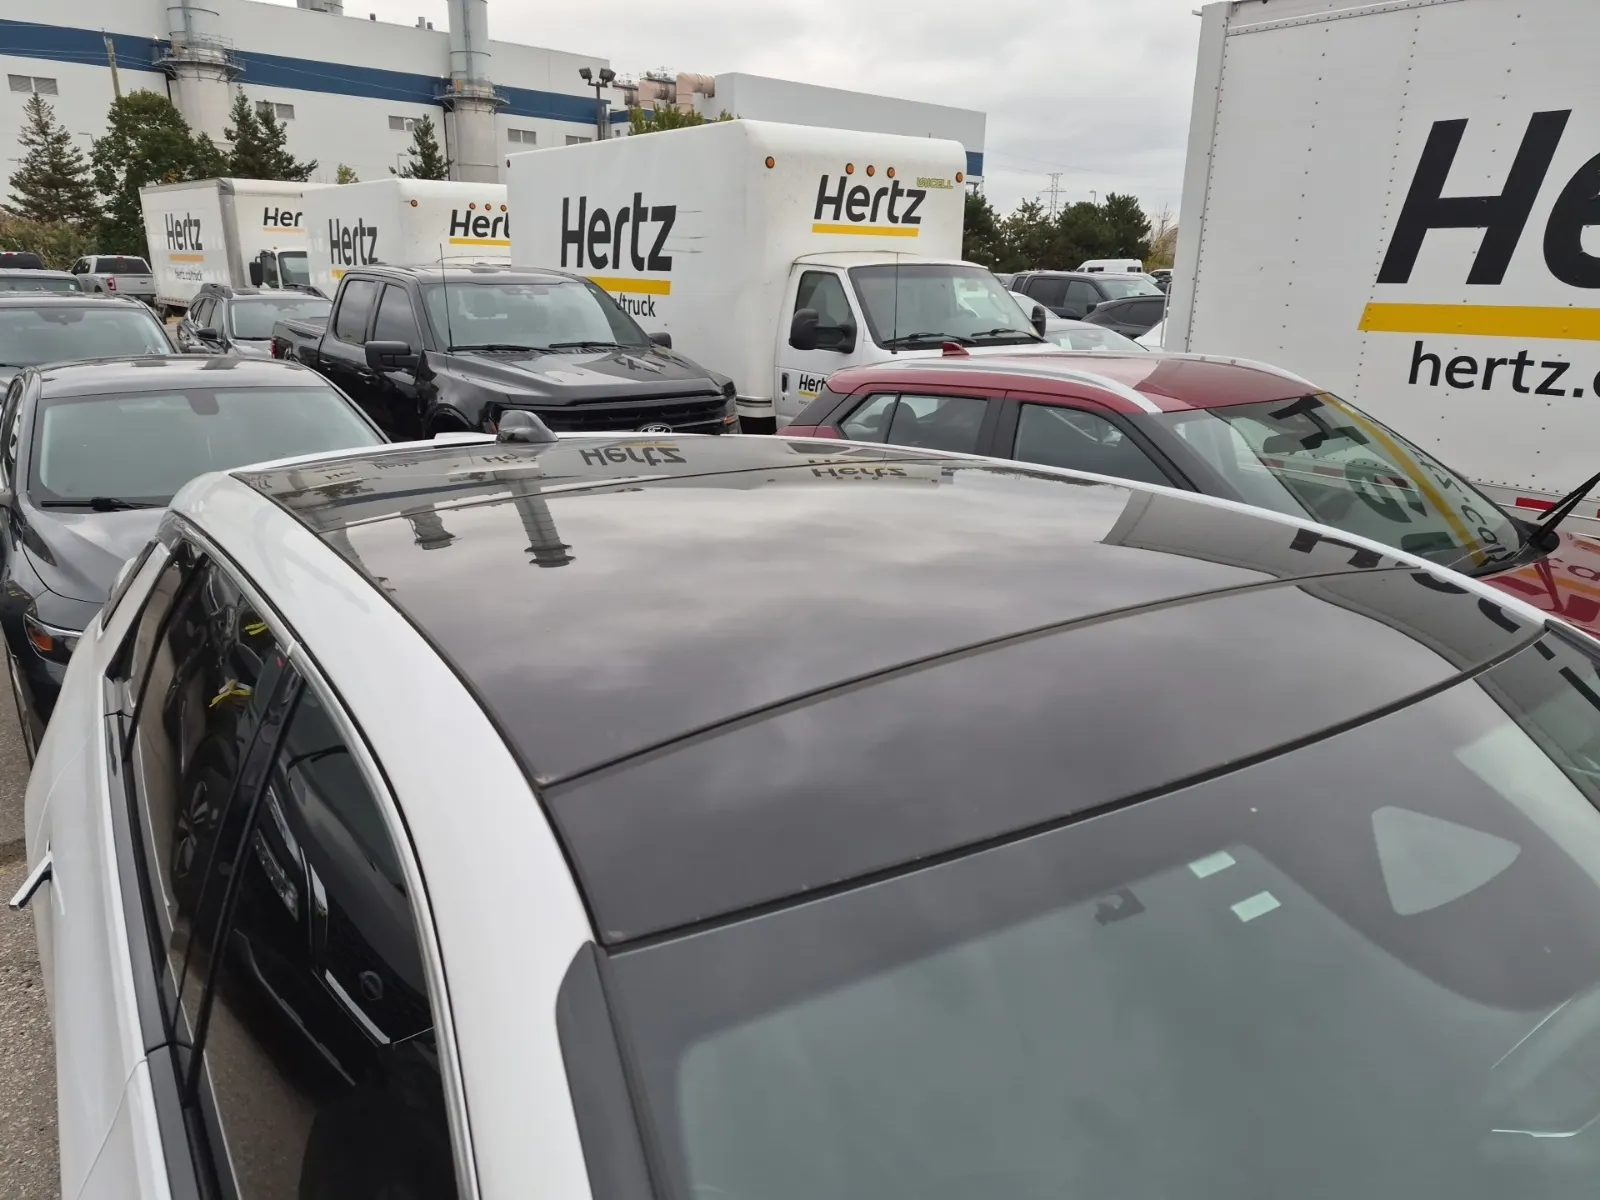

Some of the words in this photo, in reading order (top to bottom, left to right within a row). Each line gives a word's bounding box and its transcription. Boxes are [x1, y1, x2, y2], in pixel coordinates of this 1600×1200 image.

[814, 175, 926, 224] Hertz
[165, 212, 203, 251] Hertz
[329, 217, 378, 266] Hertz
[560, 192, 677, 271] Hertz
[1408, 340, 1600, 399] hertz.
